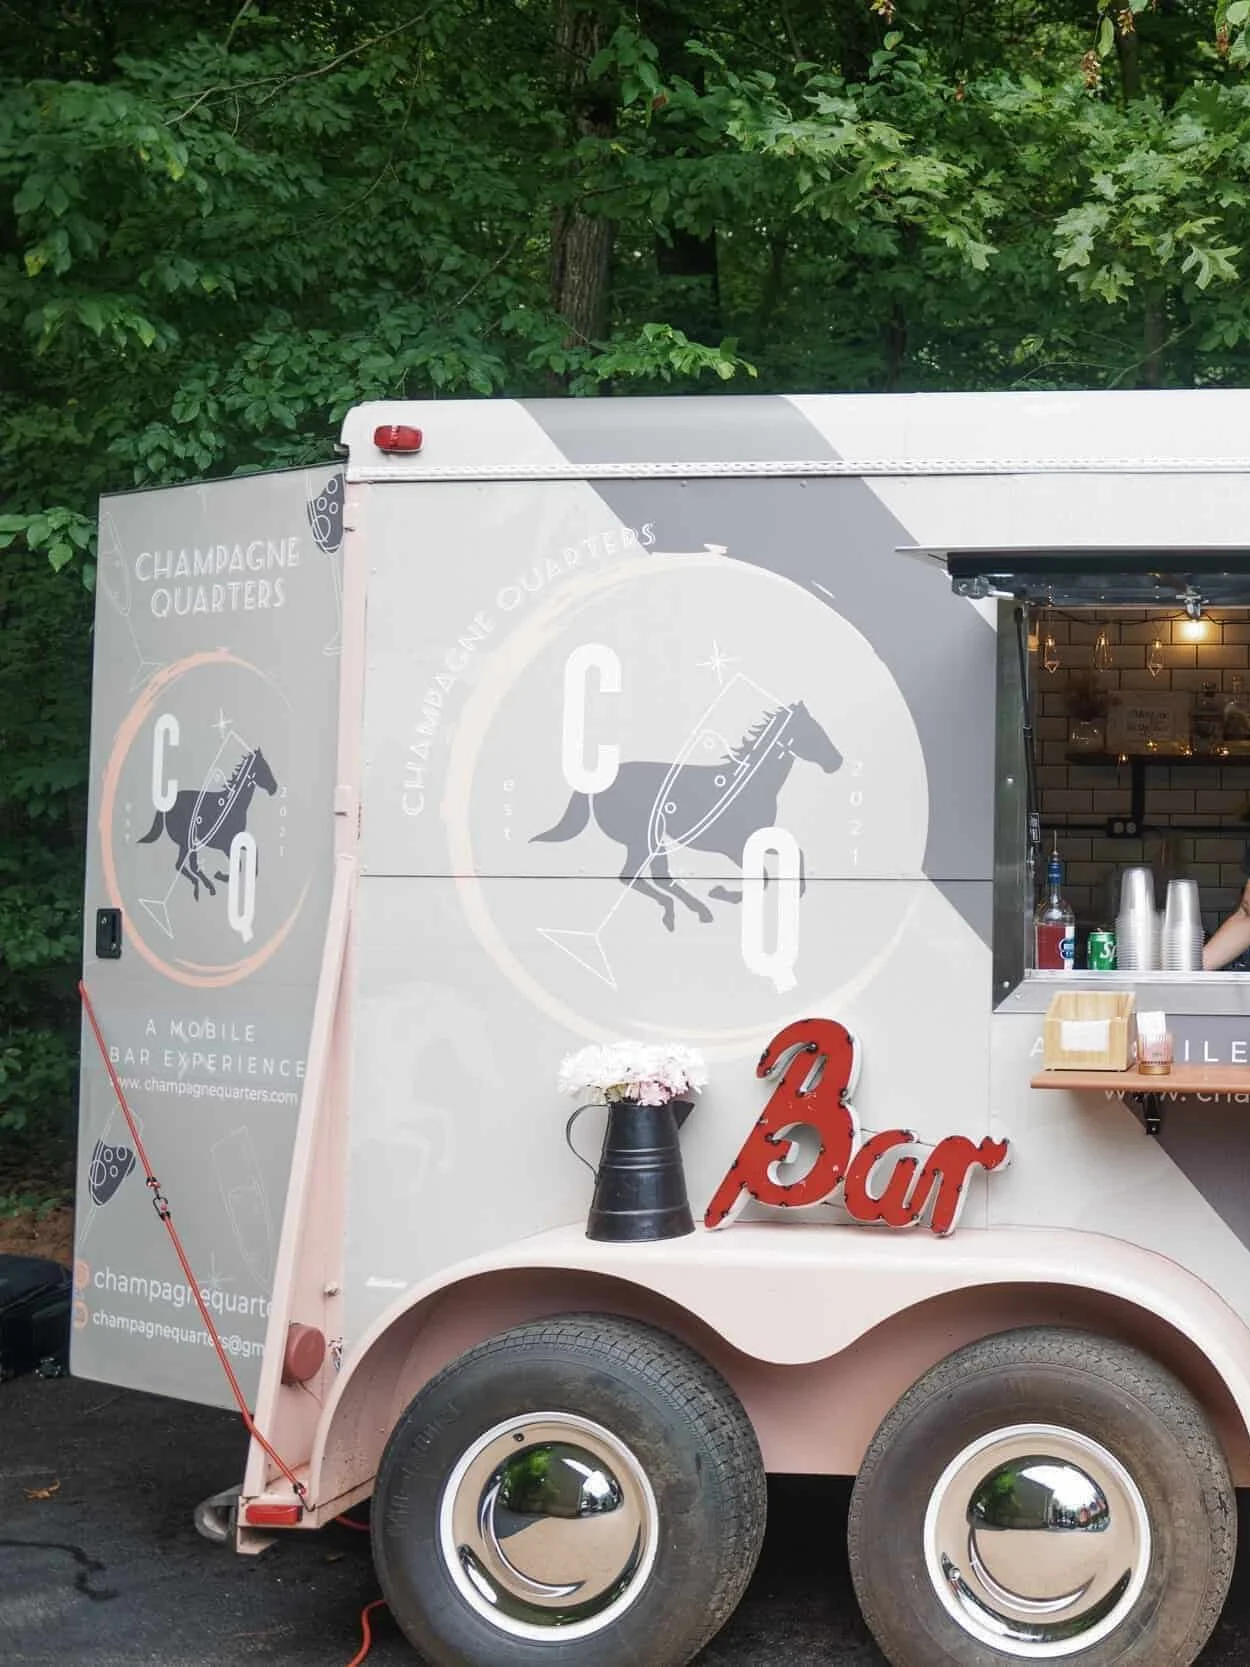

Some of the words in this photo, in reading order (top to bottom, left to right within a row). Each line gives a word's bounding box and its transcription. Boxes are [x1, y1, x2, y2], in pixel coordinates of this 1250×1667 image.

[134, 536, 299, 581] CHAMPAGNE
[150, 578, 285, 617] QUARTERS
[401, 610, 496, 816] CHAMPAGNE
[496, 523, 657, 611] QUARTERS
[562, 643, 622, 794] C
[152, 713, 180, 812] C
[110, 1046, 150, 1065] BAR
[164, 1050, 305, 1078] EXPERIENCE
[145, 1019, 156, 1036] A
[170, 1019, 256, 1042] MOBILE
[704, 1018, 1012, 1237] Bar
